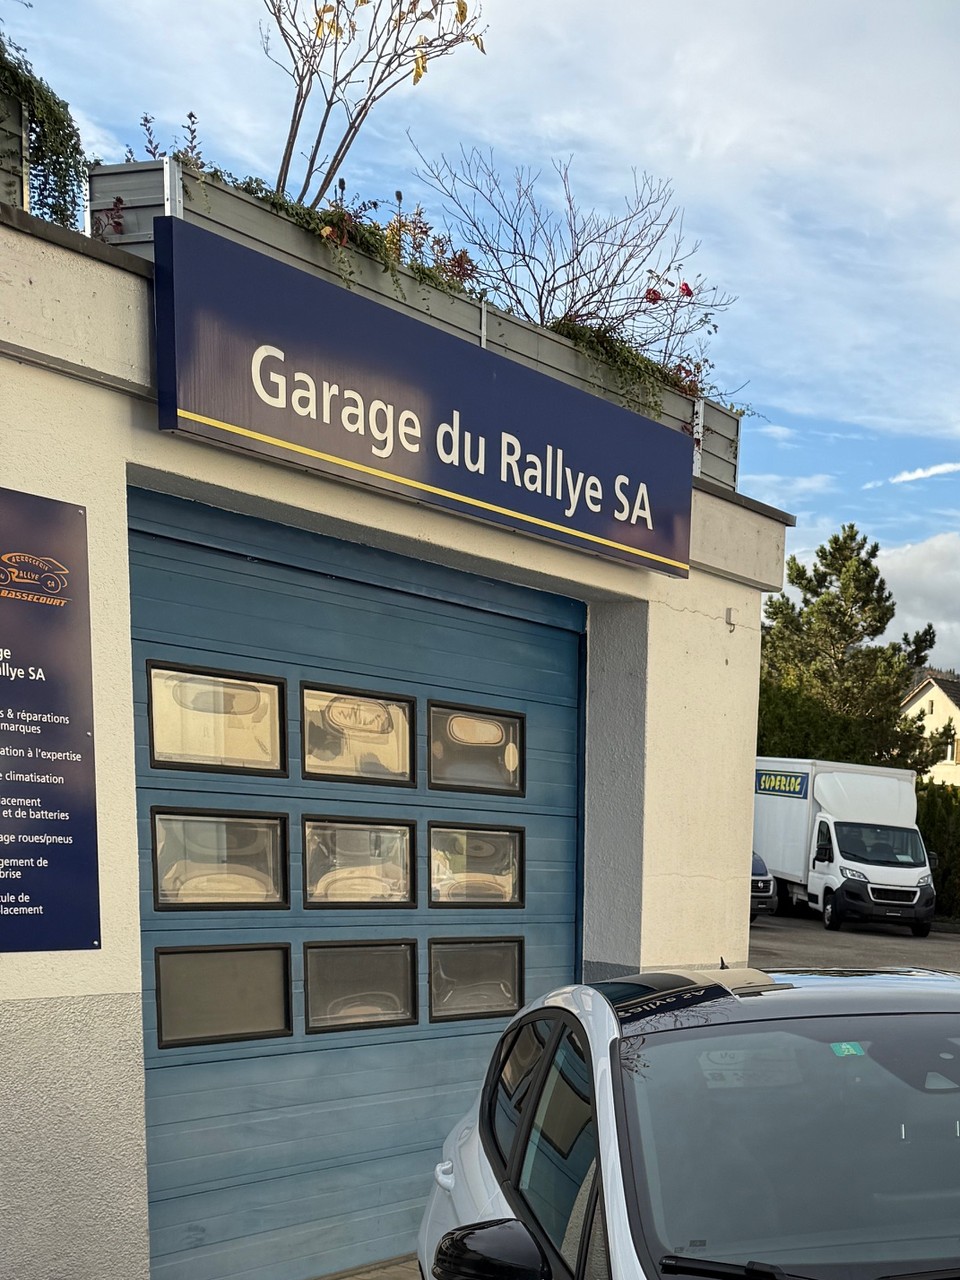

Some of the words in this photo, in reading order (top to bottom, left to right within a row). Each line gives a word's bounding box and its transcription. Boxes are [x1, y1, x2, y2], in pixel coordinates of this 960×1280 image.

[251, 344, 422, 458] Garage
[435, 410, 486, 475] du
[500, 431, 603, 518] Rallye
[613, 474, 655, 531] SA
[7, 568, 40, 583] RALLYE
[47, 580, 56, 588] SA
[1, 589, 67, 607] BASSECOURT
[0, 662, 25, 680] llye
[28, 667, 46, 681] SA
[7, 708, 14, 719] &
[17, 710, 70, 725] réparations
[1, 722, 41, 735] marques
[0, 746, 25, 757] ation
[27, 747, 33, 758] à
[35, 748, 82, 762] l'expertise
[5, 770, 64, 784] climatisation
[760, 774, 802, 792] SUPERLOG
[1, 797, 41, 807] acement
[2, 809, 12, 818] et
[14, 808, 27, 818] de
[29, 808, 70, 820] batteries
[18, 833, 73, 845] roues/pneus
[36, 857, 49, 867] de
[17, 892, 30, 902] de
[1, 904, 43, 915] lacement
